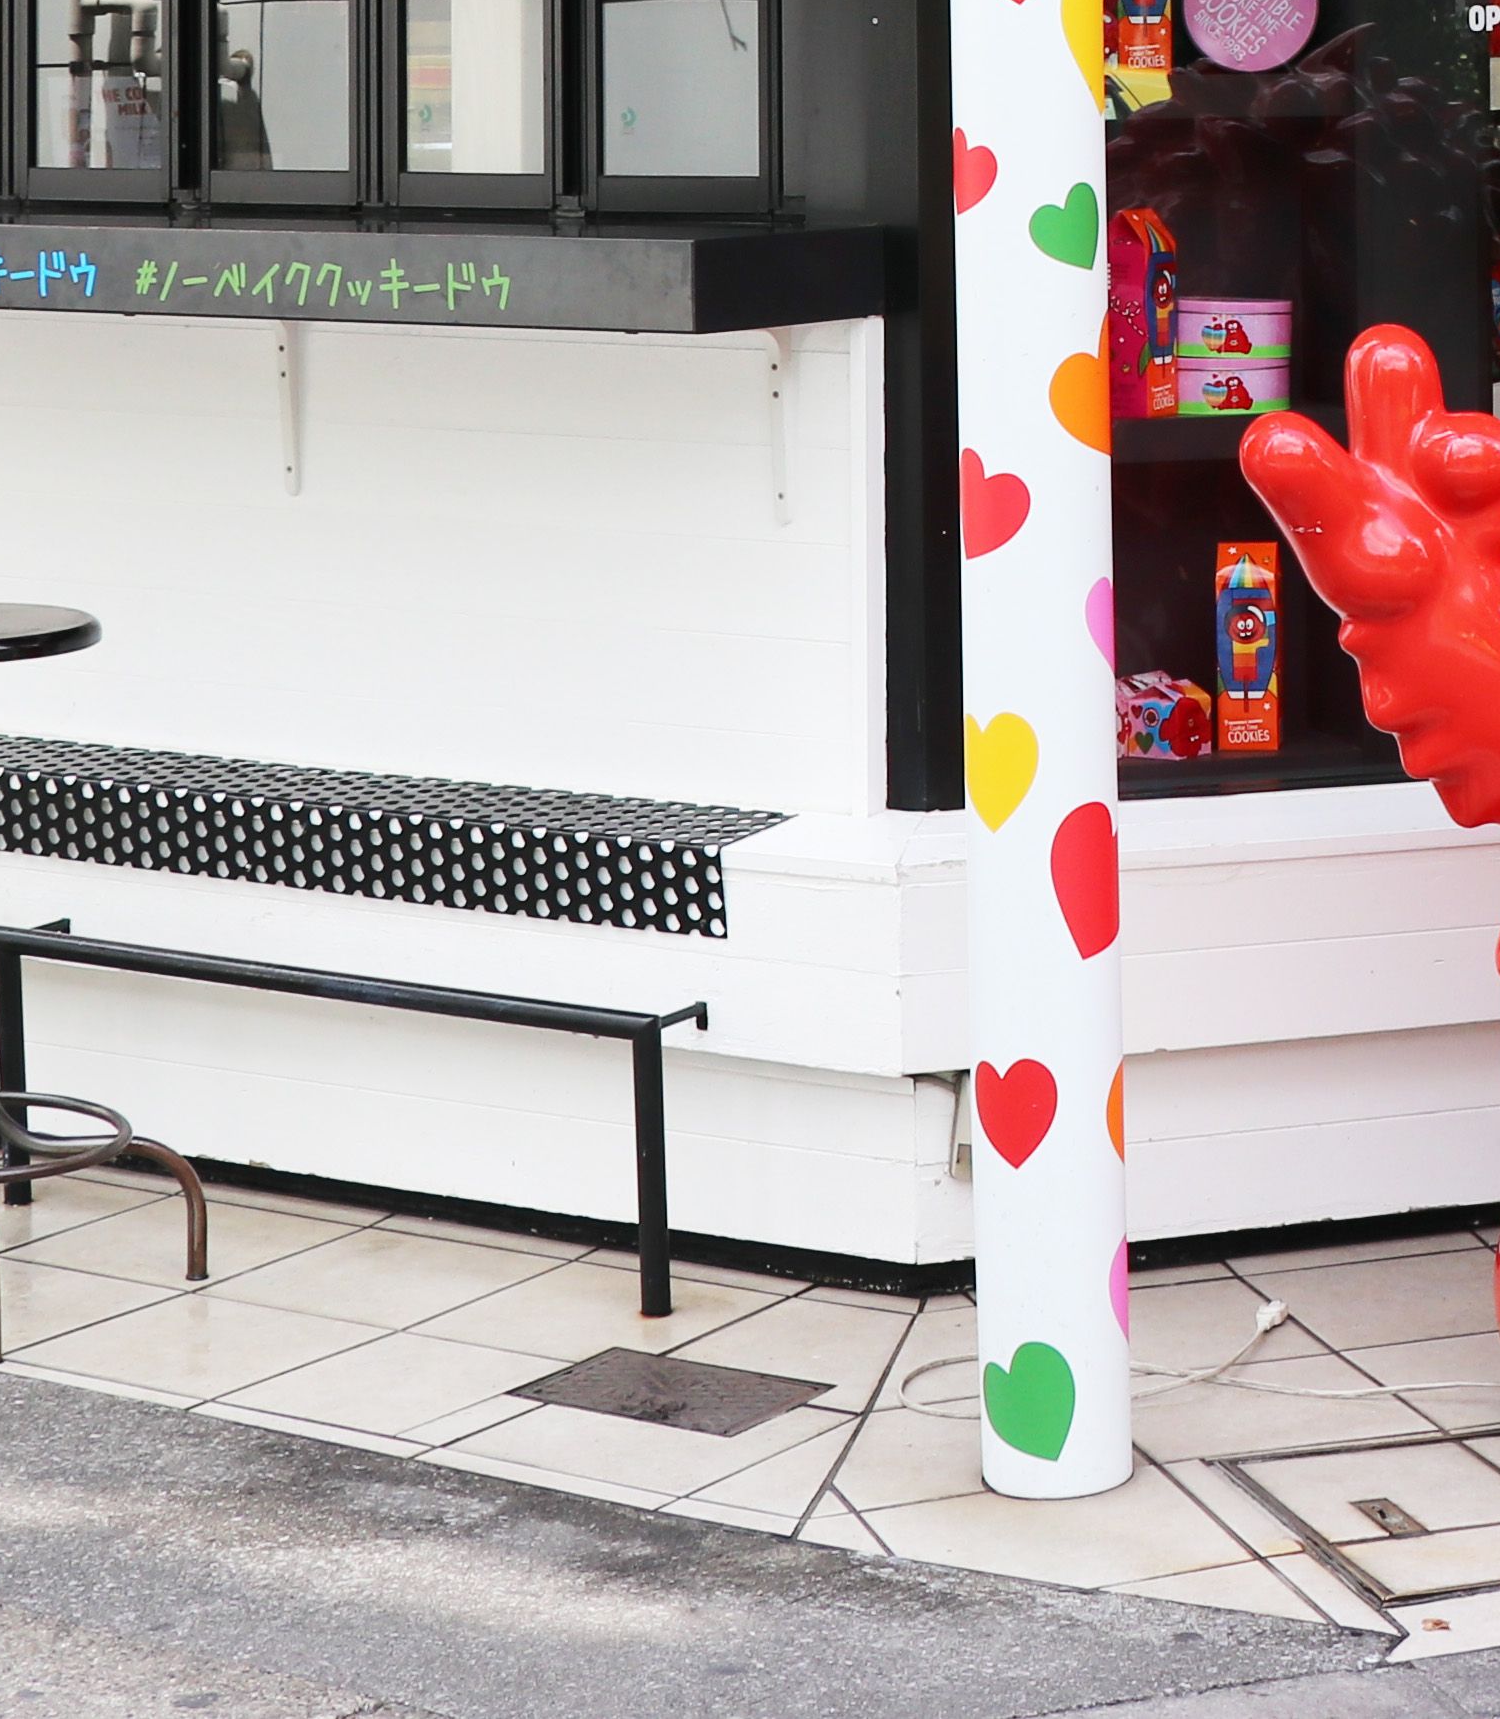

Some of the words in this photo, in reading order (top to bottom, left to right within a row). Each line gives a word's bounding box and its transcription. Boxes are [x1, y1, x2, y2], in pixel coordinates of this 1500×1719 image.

[1193, 8, 1225, 40] SINCE
[1254, 7, 1282, 36] TIME
[1127, 54, 1166, 69] COOKIES
[1227, 728, 1271, 744] COOKIES
